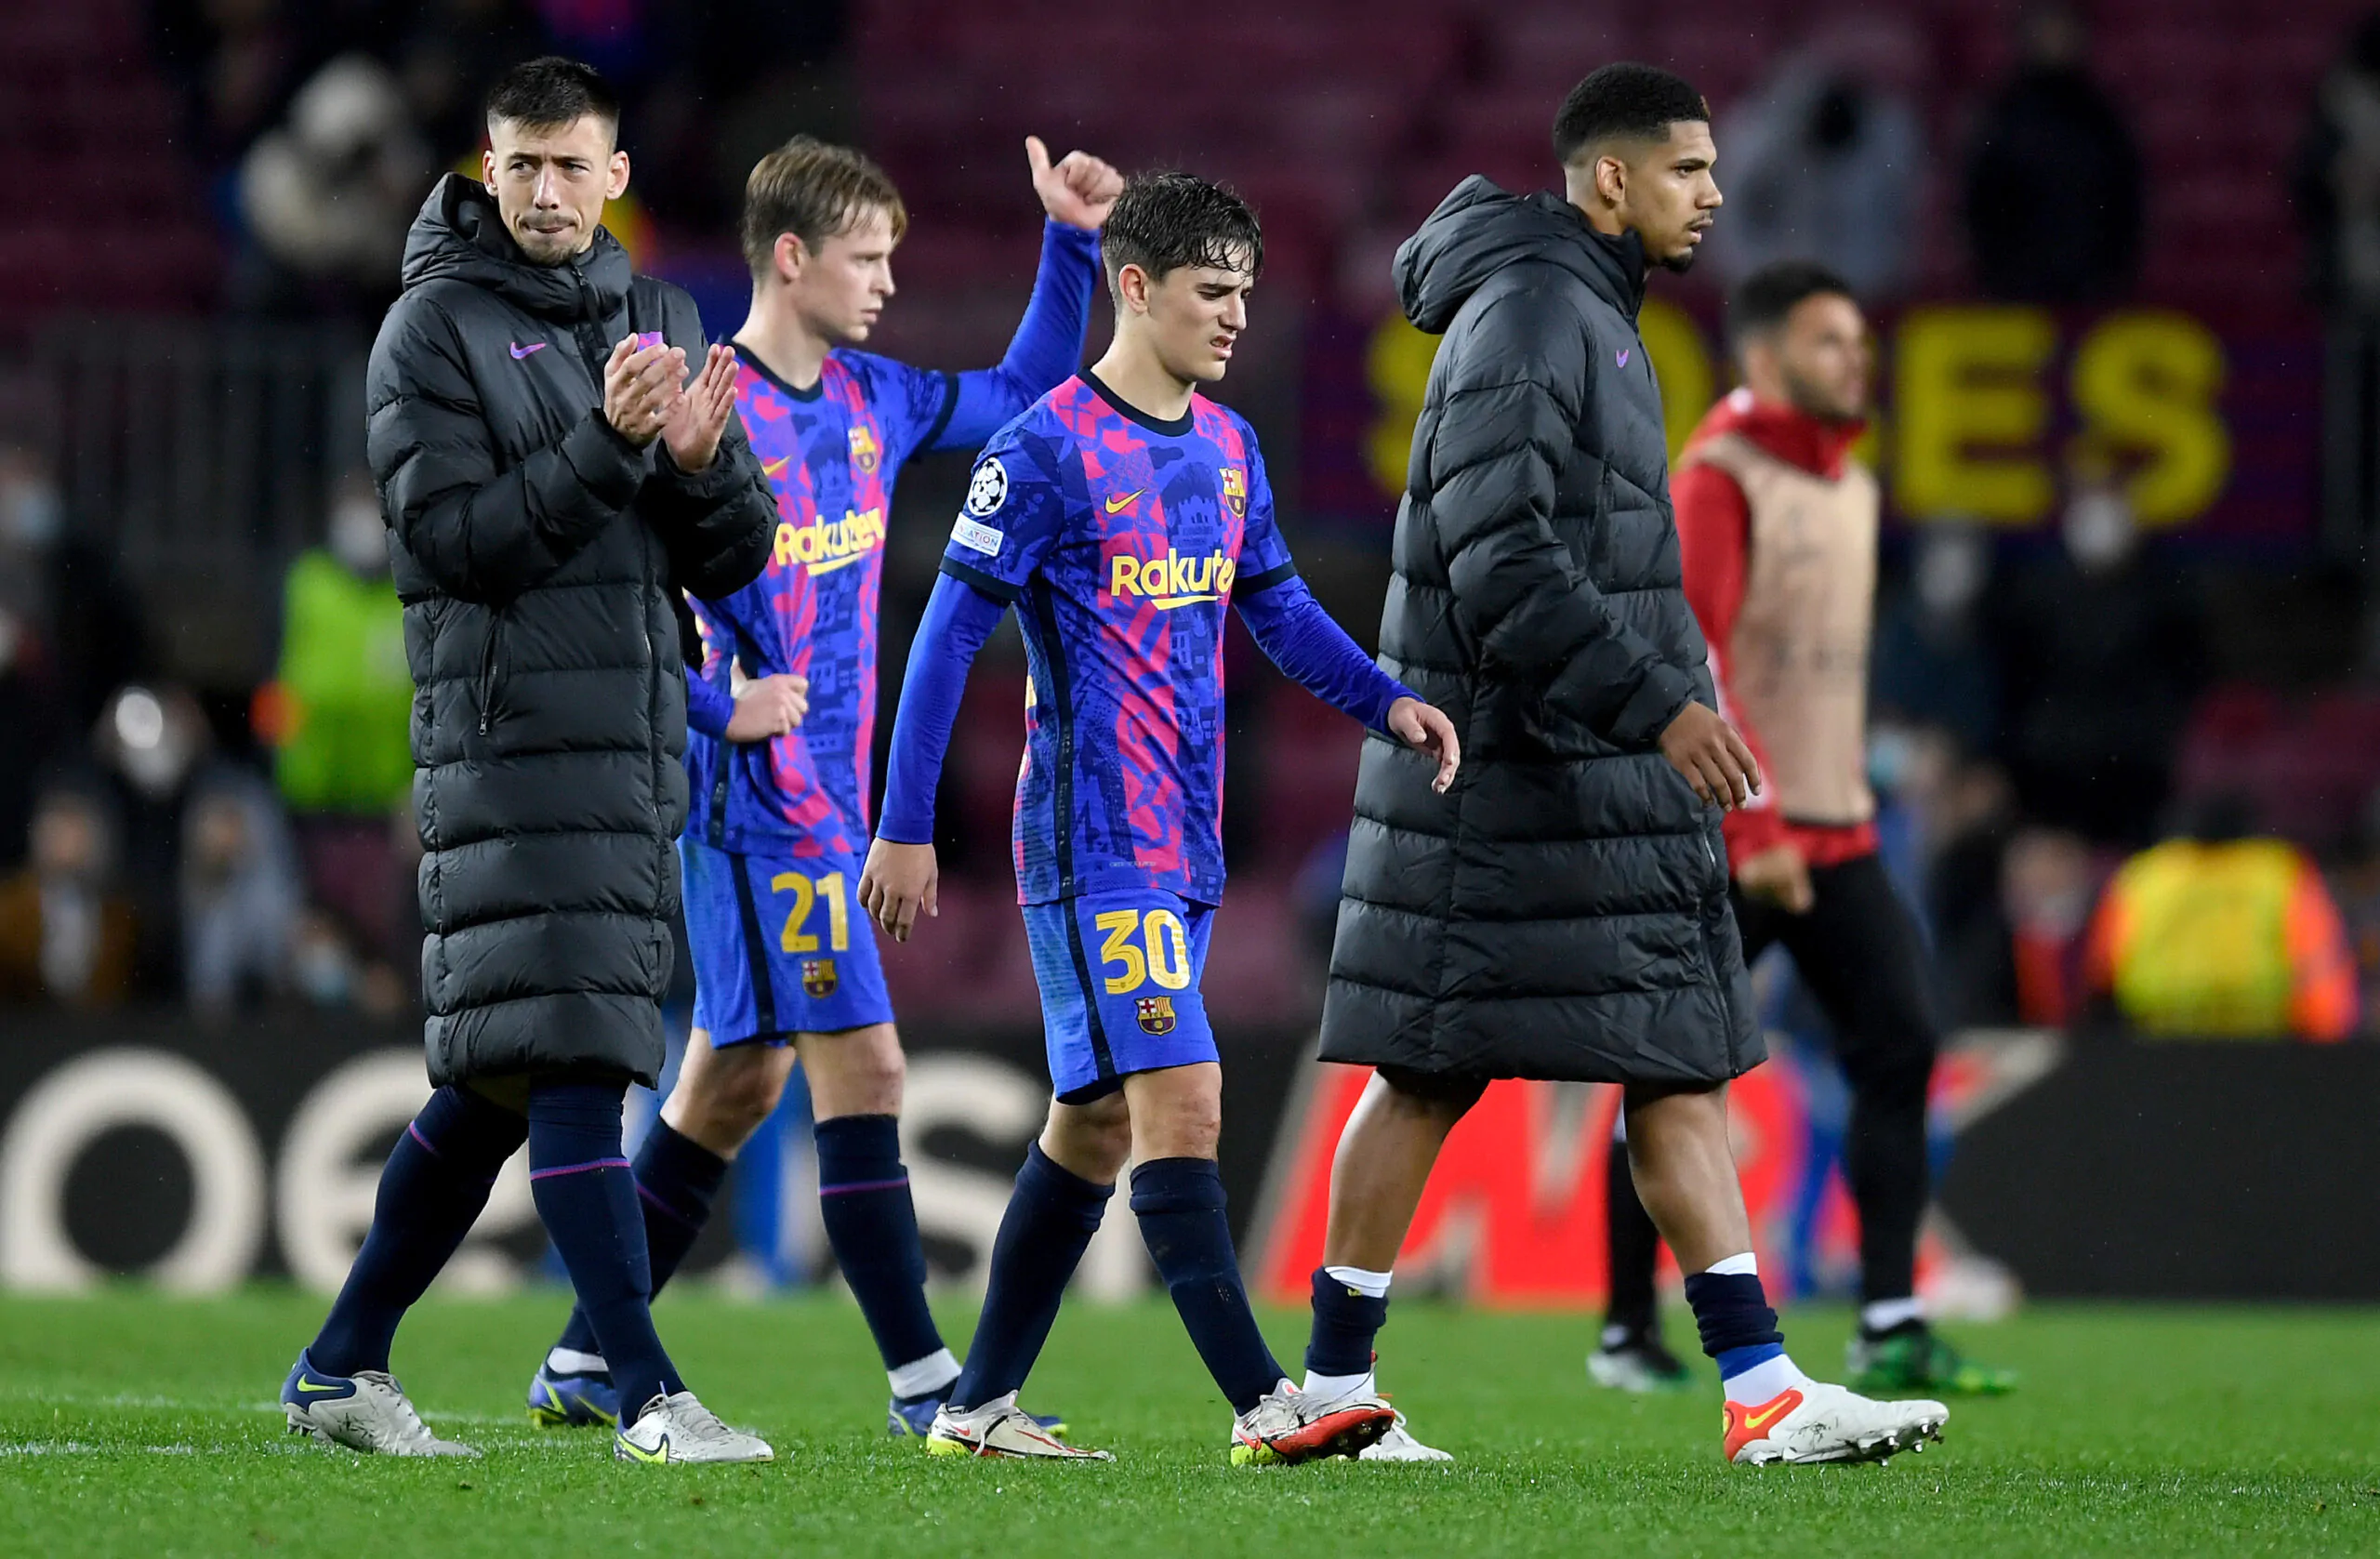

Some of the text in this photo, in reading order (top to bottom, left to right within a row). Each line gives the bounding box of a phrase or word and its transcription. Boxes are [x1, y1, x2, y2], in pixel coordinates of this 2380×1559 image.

[1111, 548, 1236, 596] Rakute
[771, 872, 848, 952] 21
[1095, 909, 1190, 994] 30
